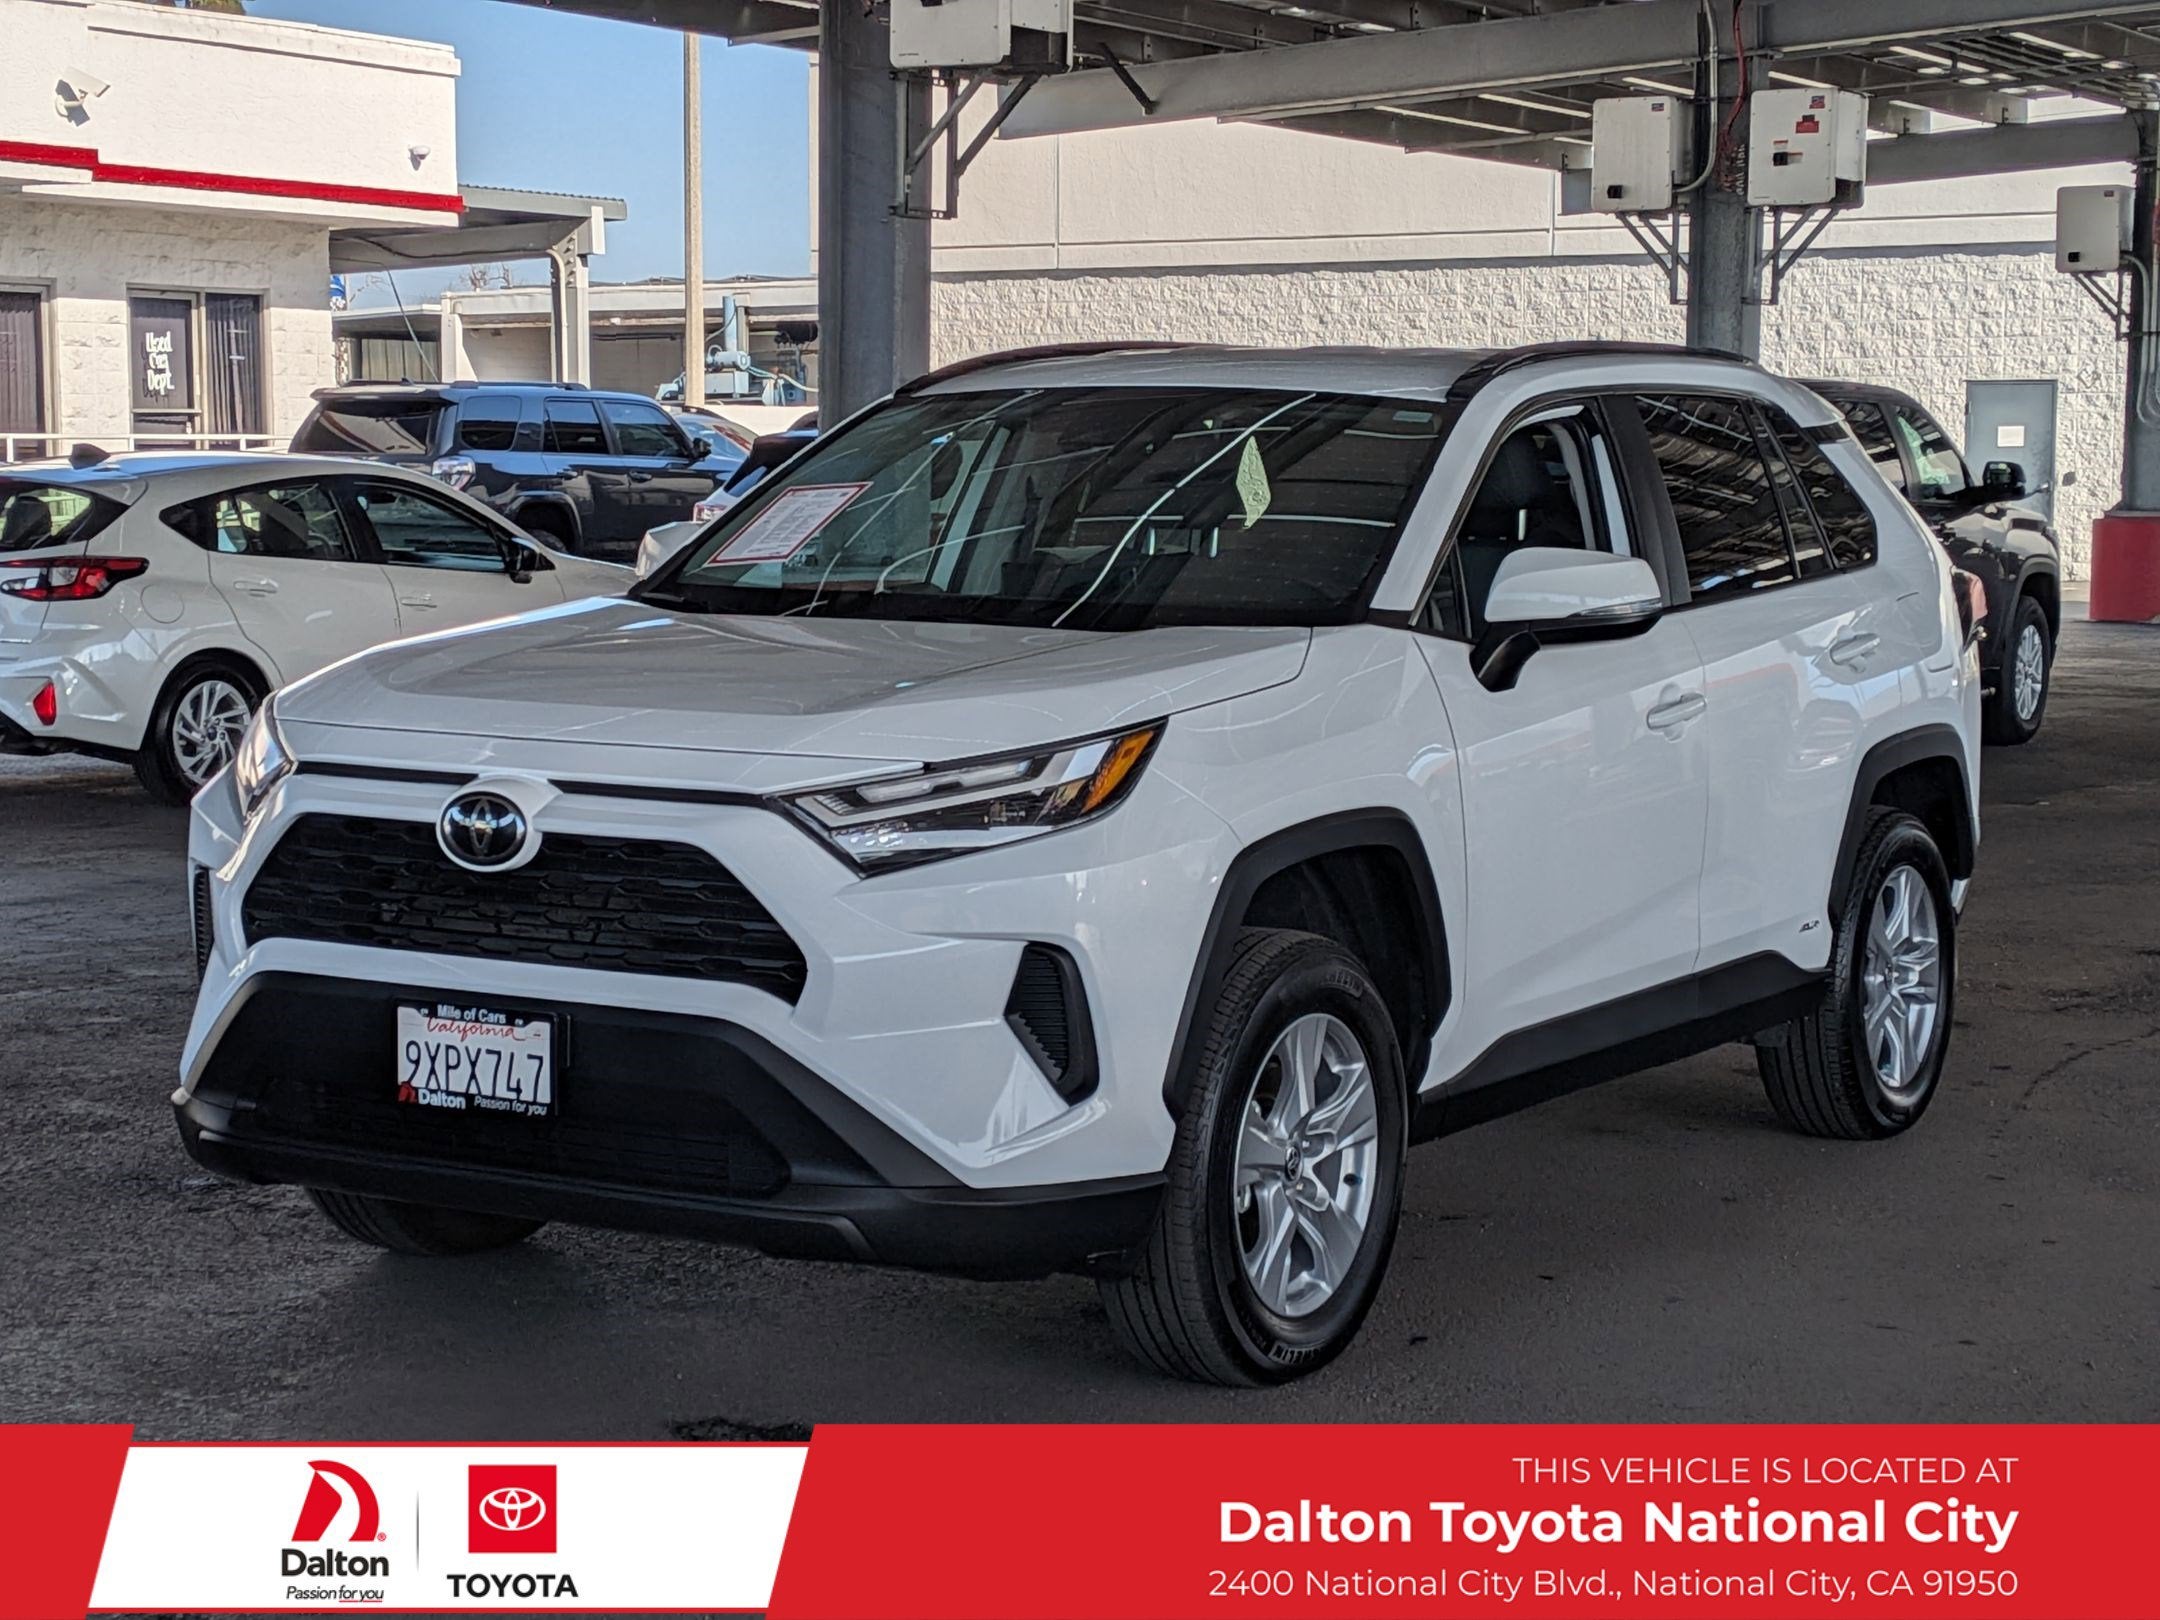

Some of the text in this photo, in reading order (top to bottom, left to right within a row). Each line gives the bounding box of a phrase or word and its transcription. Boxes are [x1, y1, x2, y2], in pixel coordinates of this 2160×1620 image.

[145, 331, 173, 352] Used
[437, 1005, 507, 1023] Mile of Cars
[426, 1018, 526, 1042] California
[406, 1040, 543, 1103] 9XPX747
[418, 1088, 547, 1116] Dalton Passion for you
